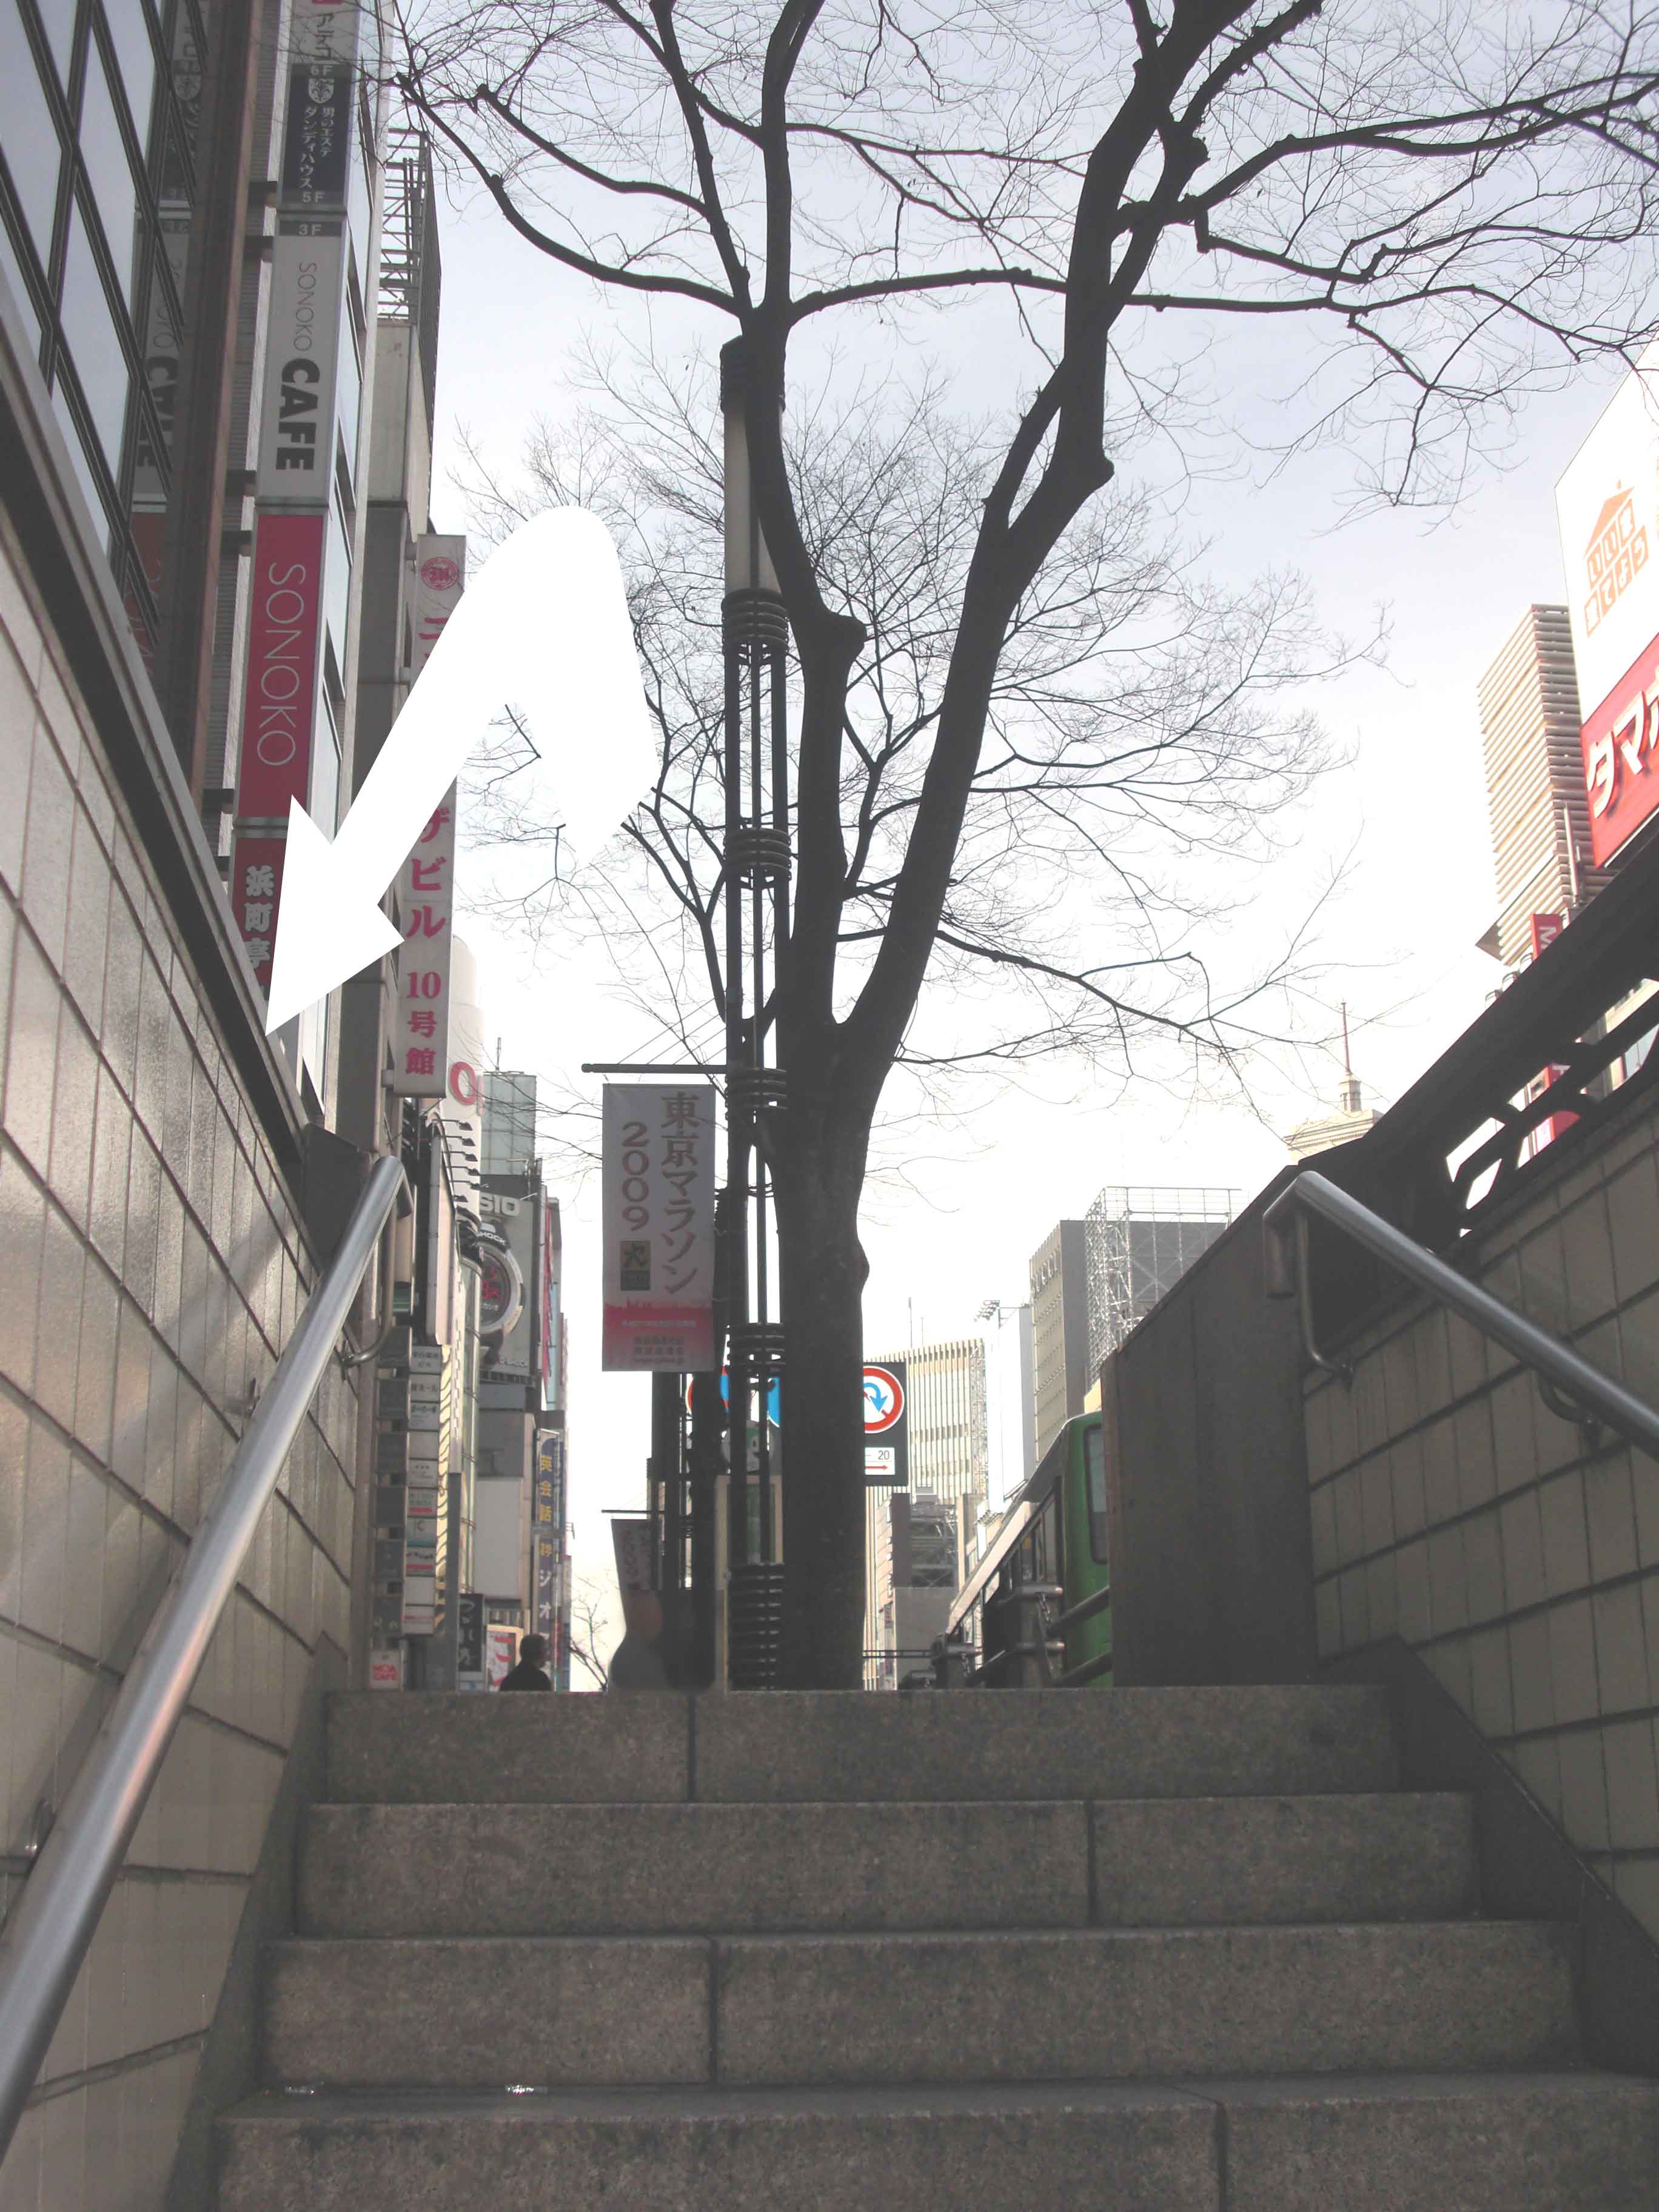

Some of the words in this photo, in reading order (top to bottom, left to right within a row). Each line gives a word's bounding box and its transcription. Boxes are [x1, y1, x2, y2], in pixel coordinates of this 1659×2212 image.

[300, 106, 318, 189] ダンディハウス
[302, 190, 326, 204] 5F
[298, 224, 323, 236] 3F
[293, 262, 317, 351] SONOKO
[275, 358, 320, 471] CAFE
[256, 562, 306, 766] SONOKO
[622, 1121, 650, 1232] 2009
[660, 1091, 699, 1295] 東京マラソン
